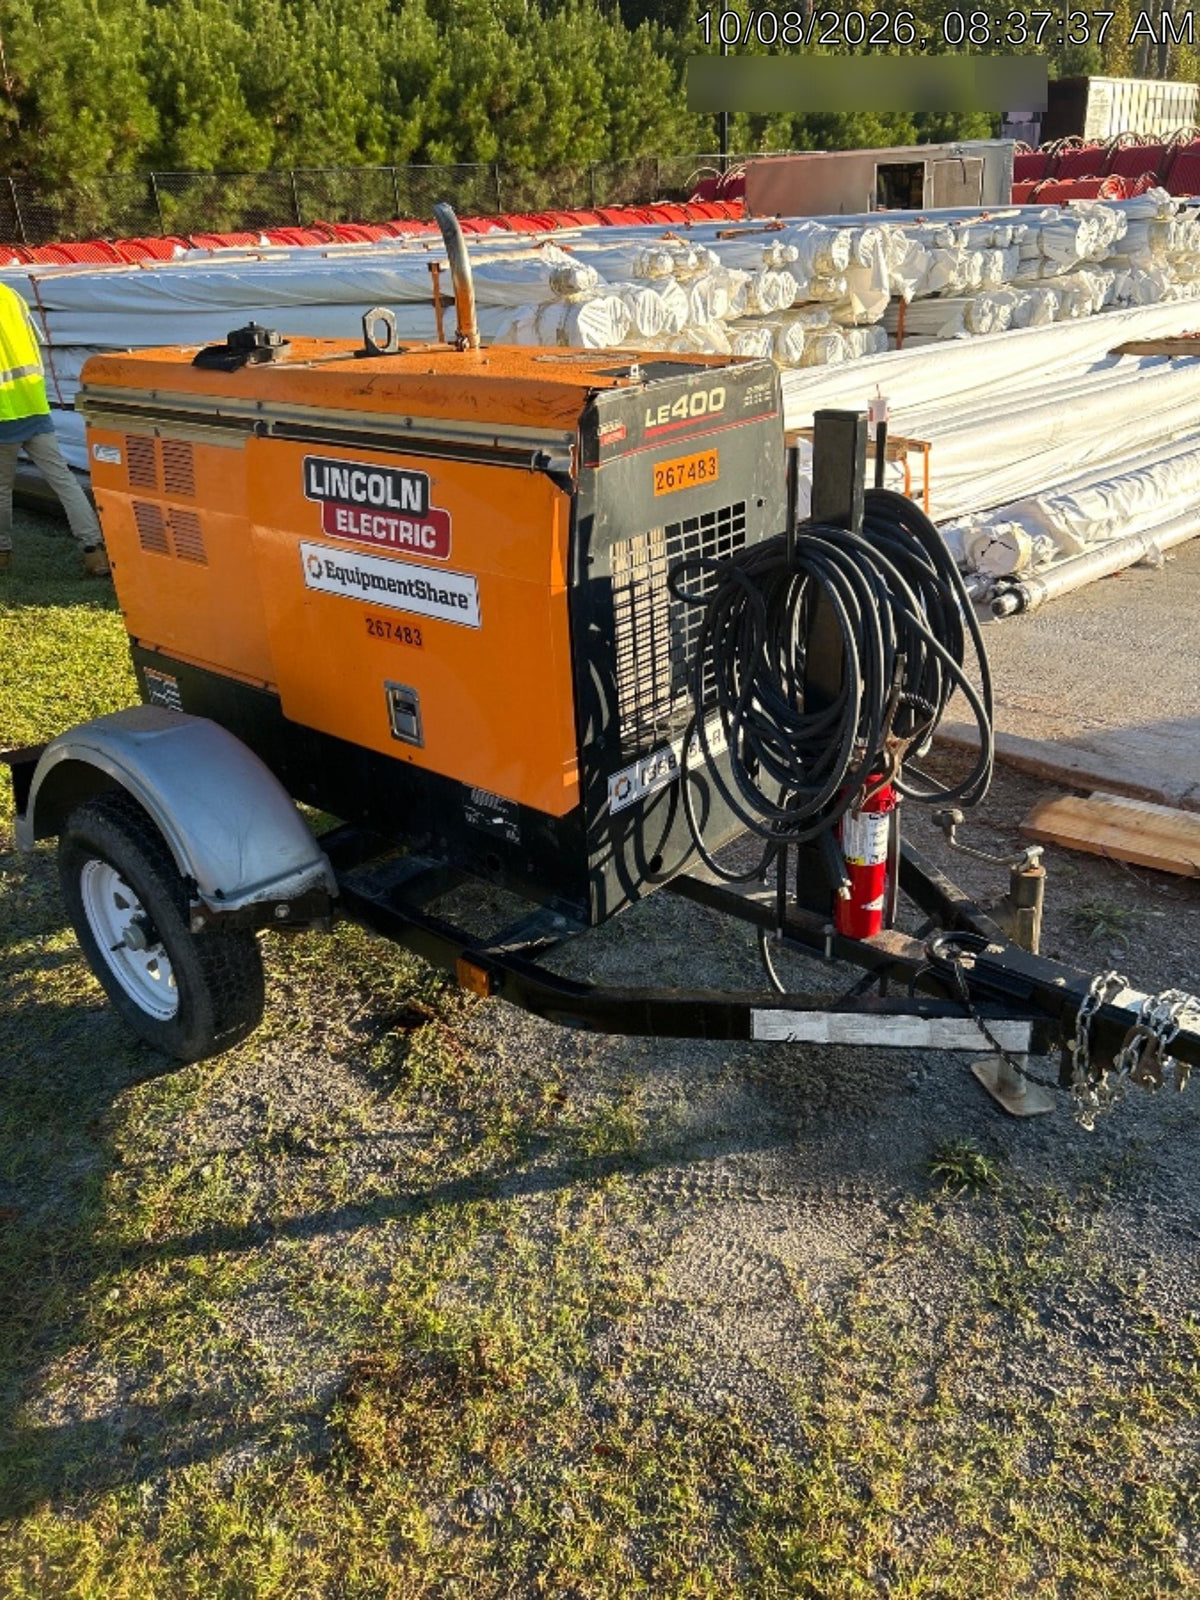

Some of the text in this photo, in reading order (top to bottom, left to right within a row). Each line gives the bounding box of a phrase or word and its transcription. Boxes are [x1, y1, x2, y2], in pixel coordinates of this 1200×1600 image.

[645, 387, 726, 427] LE400
[310, 464, 422, 511] LINCOLN
[655, 456, 716, 490] 267483
[335, 508, 437, 549] ELECTRIC
[324, 559, 468, 609] EquipmentShare
[366, 617, 423, 646] 267483
